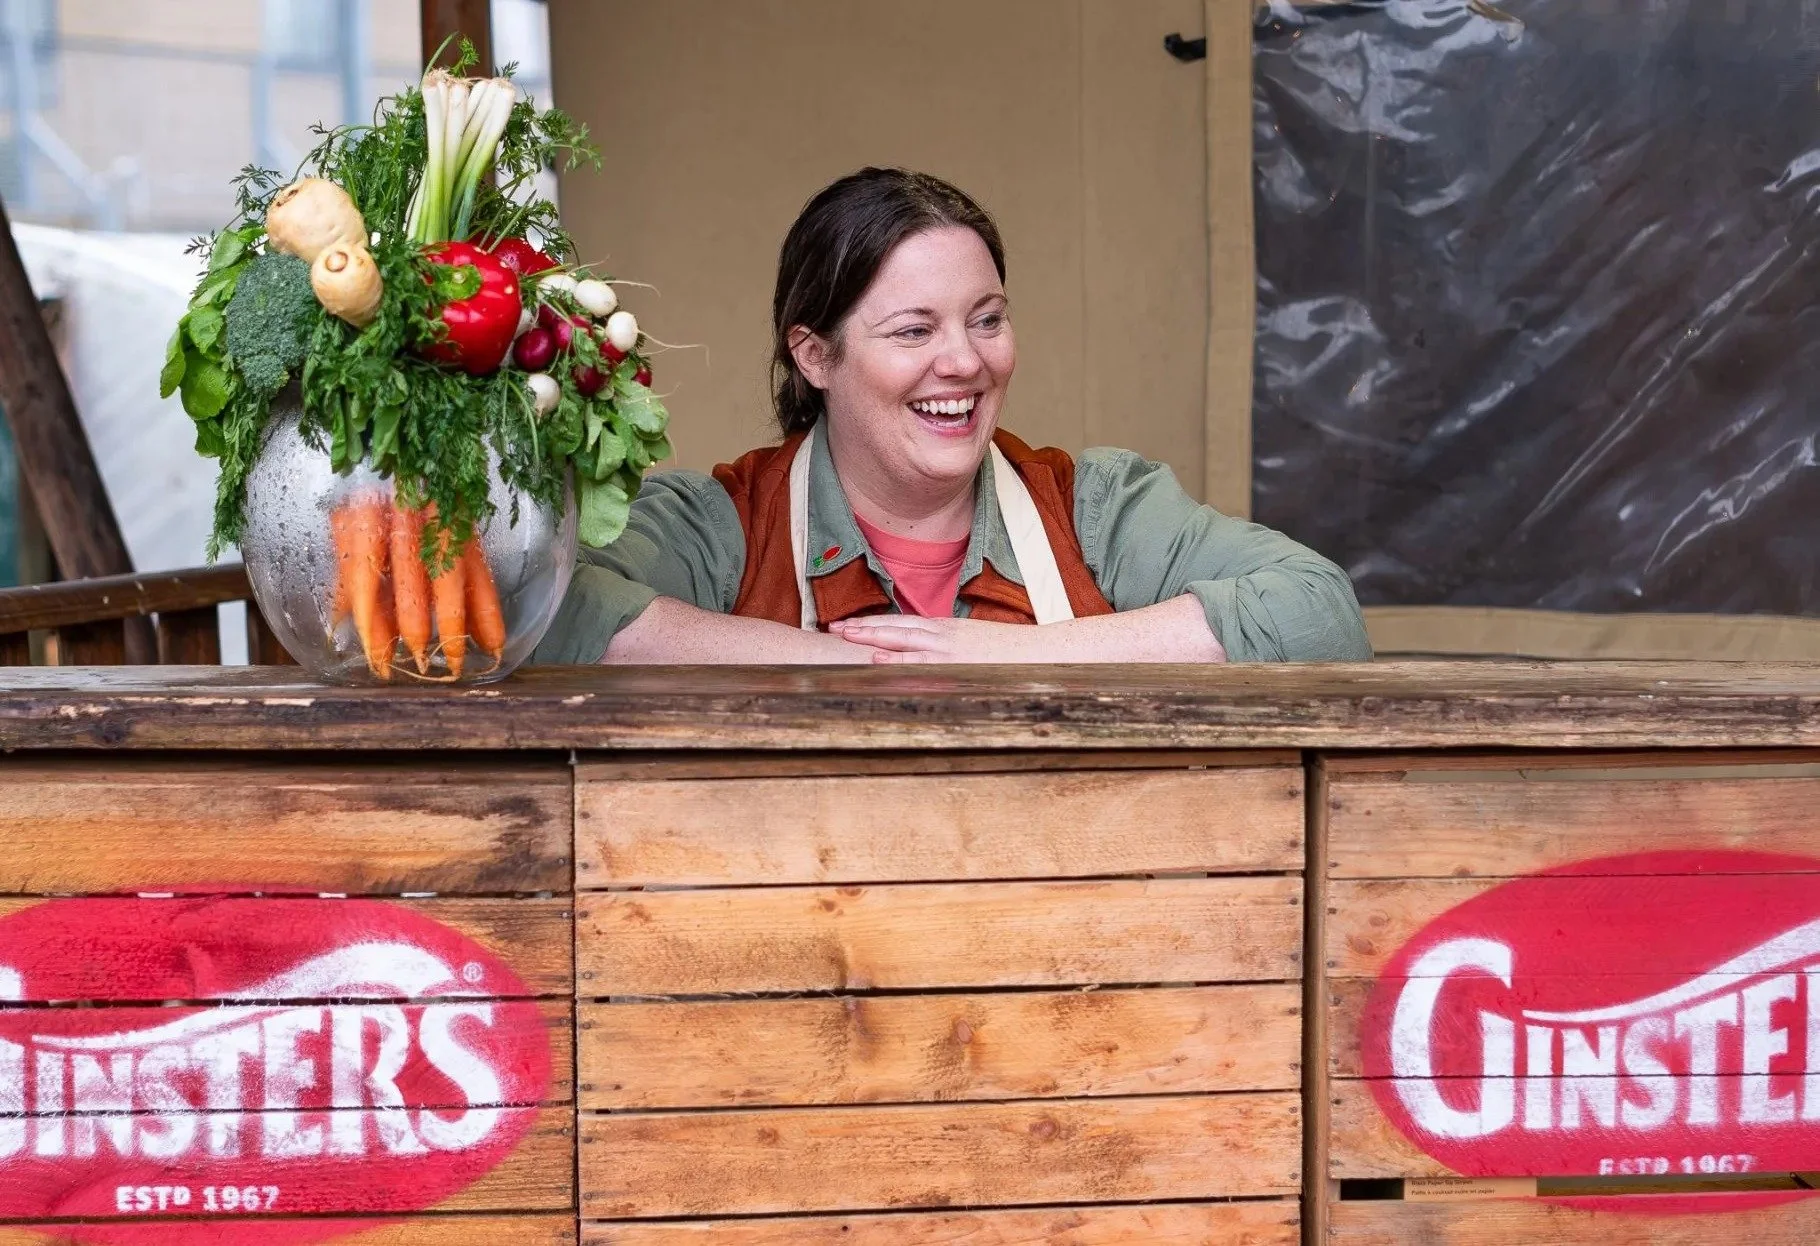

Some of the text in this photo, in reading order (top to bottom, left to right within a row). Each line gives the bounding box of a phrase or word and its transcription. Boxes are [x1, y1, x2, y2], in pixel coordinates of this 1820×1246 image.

[0, 968, 503, 1158] INSTERS
[1390, 936, 1820, 1141] GINSTE
[202, 1185, 280, 1212] 1967
